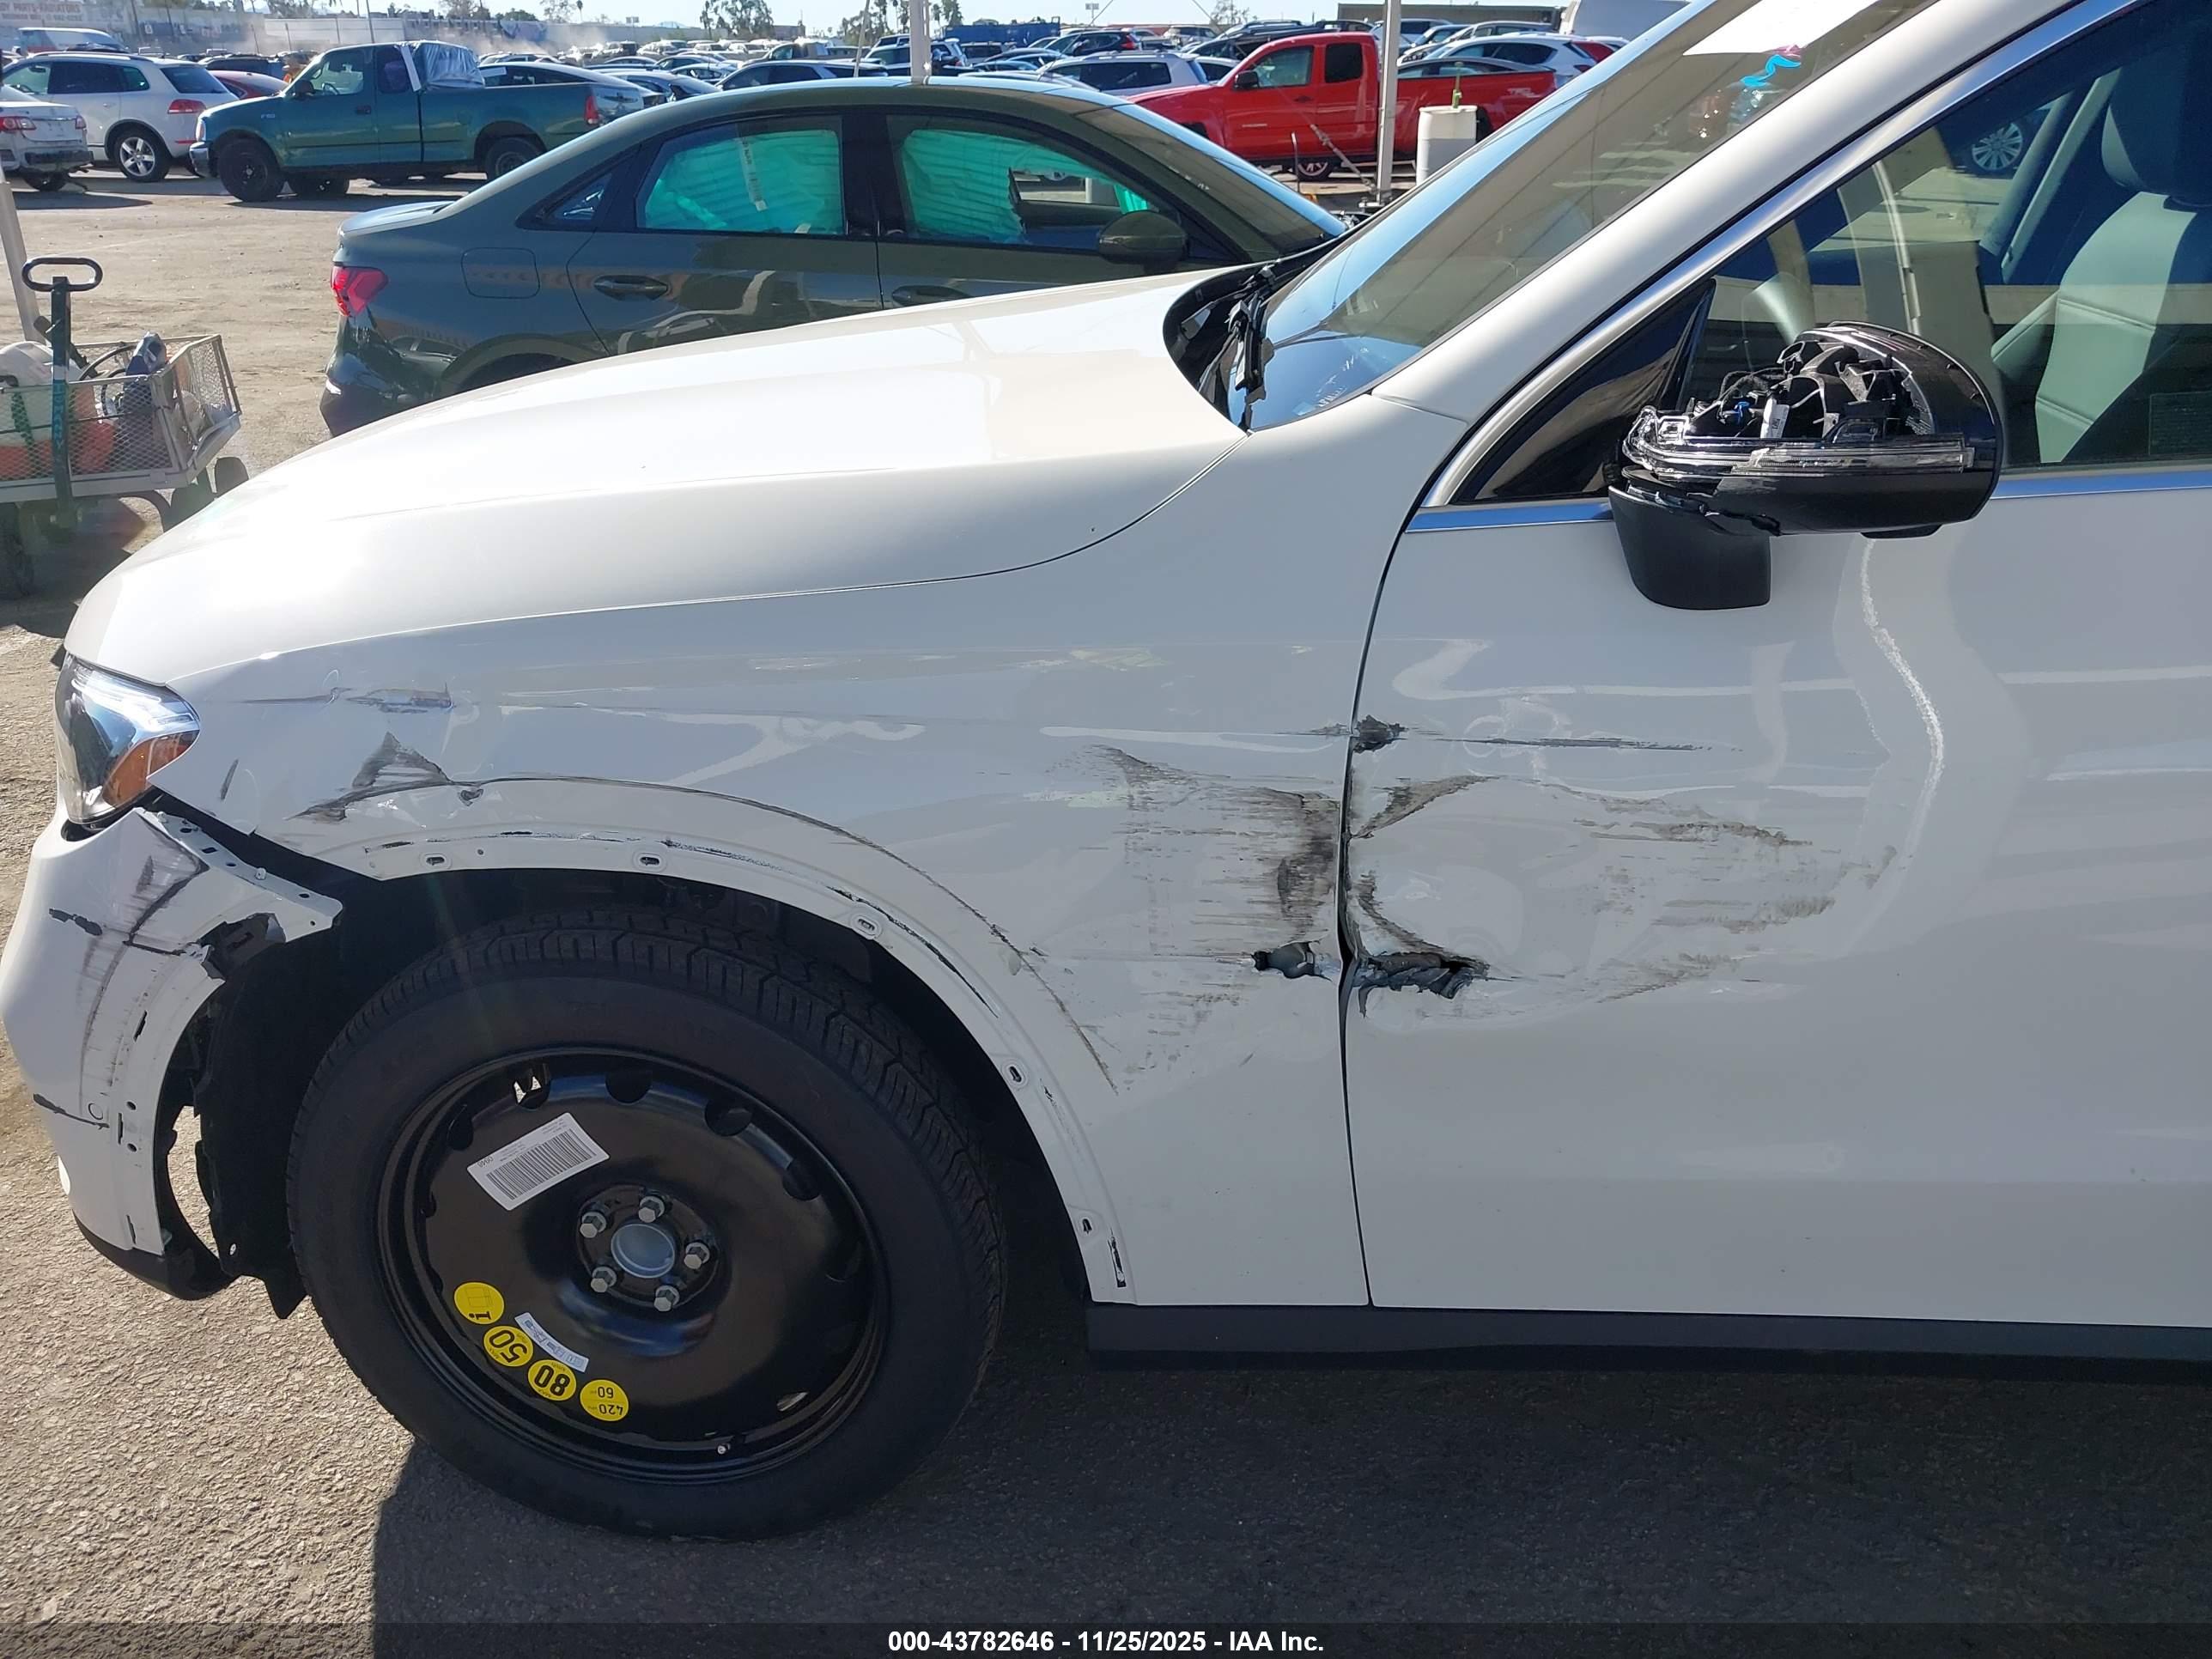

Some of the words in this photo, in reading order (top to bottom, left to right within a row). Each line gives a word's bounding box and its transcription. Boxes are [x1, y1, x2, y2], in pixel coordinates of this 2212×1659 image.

[489, 1329, 527, 1363] 50
[534, 1364, 570, 1396] 80
[598, 1386, 614, 1399] 60
[599, 1404, 623, 1416] 420
